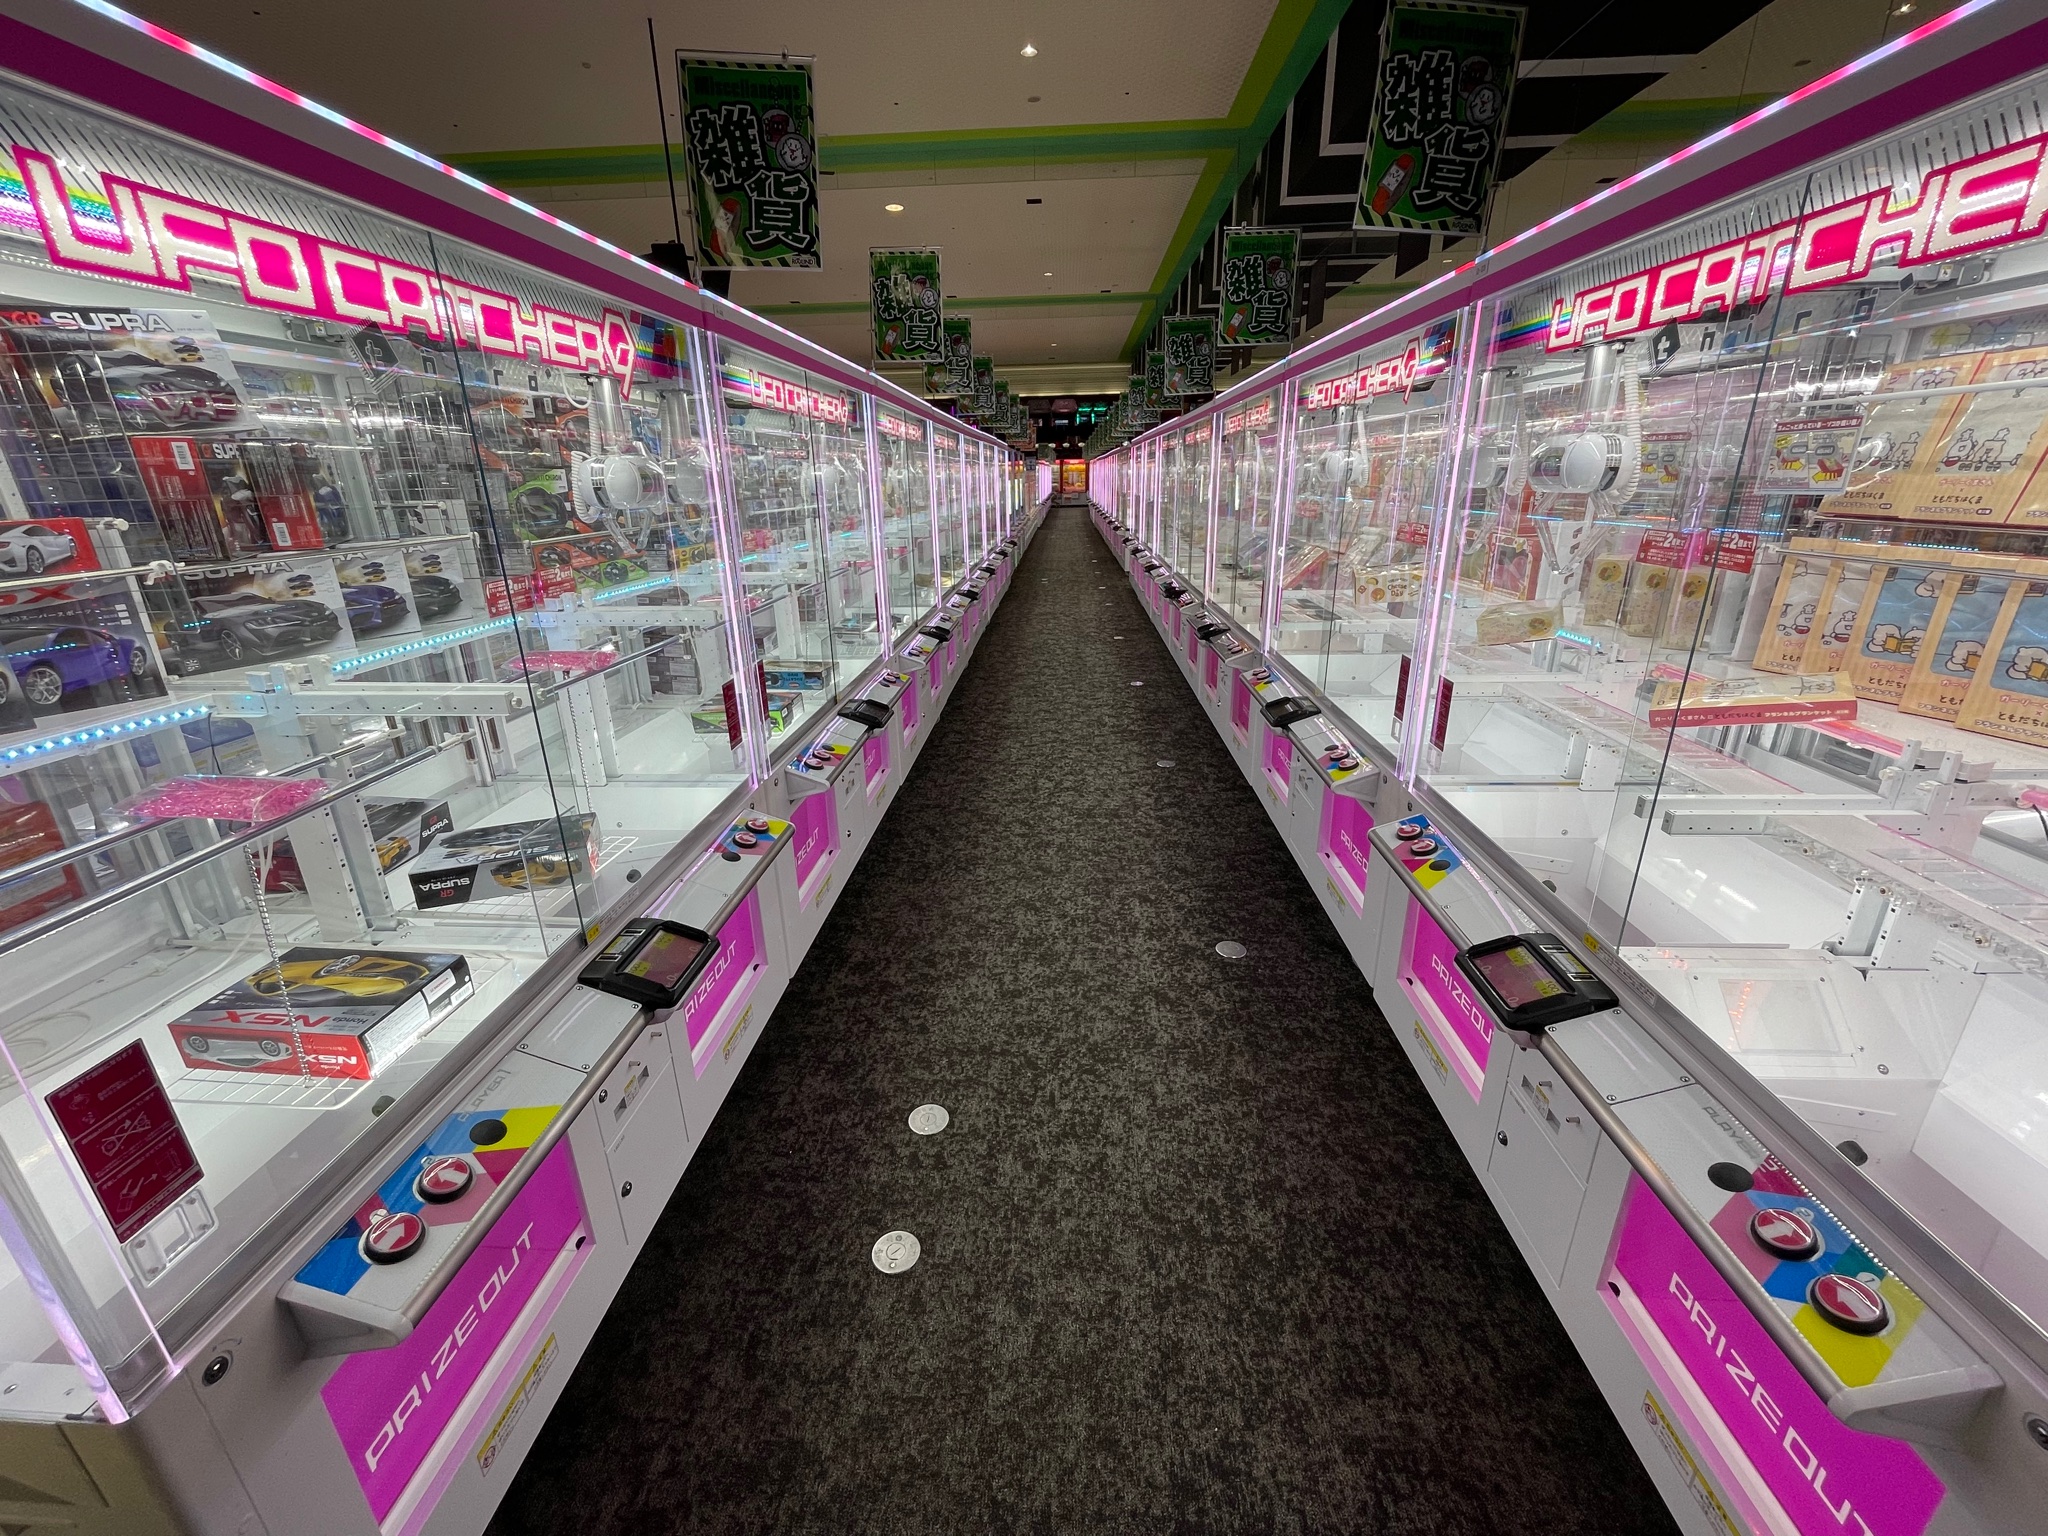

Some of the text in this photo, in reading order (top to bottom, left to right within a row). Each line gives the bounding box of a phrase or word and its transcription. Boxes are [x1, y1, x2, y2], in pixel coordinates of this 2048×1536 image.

[690, 105, 811, 248] 雑貨
[14, 146, 317, 312] UFO
[318, 241, 608, 376] CATCHER
[1546, 268, 1651, 353] UFO
[50, 312, 174, 332] SUPRA
[421, 818, 449, 839] SUPRA
[456, 845, 549, 864] SUPRA
[419, 877, 471, 892] SUPRA
[440, 889, 455, 898] GR
[209, 1010, 332, 1028] NSX
[332, 1016, 369, 1025] Honda
[303, 1054, 358, 1065] NSX
